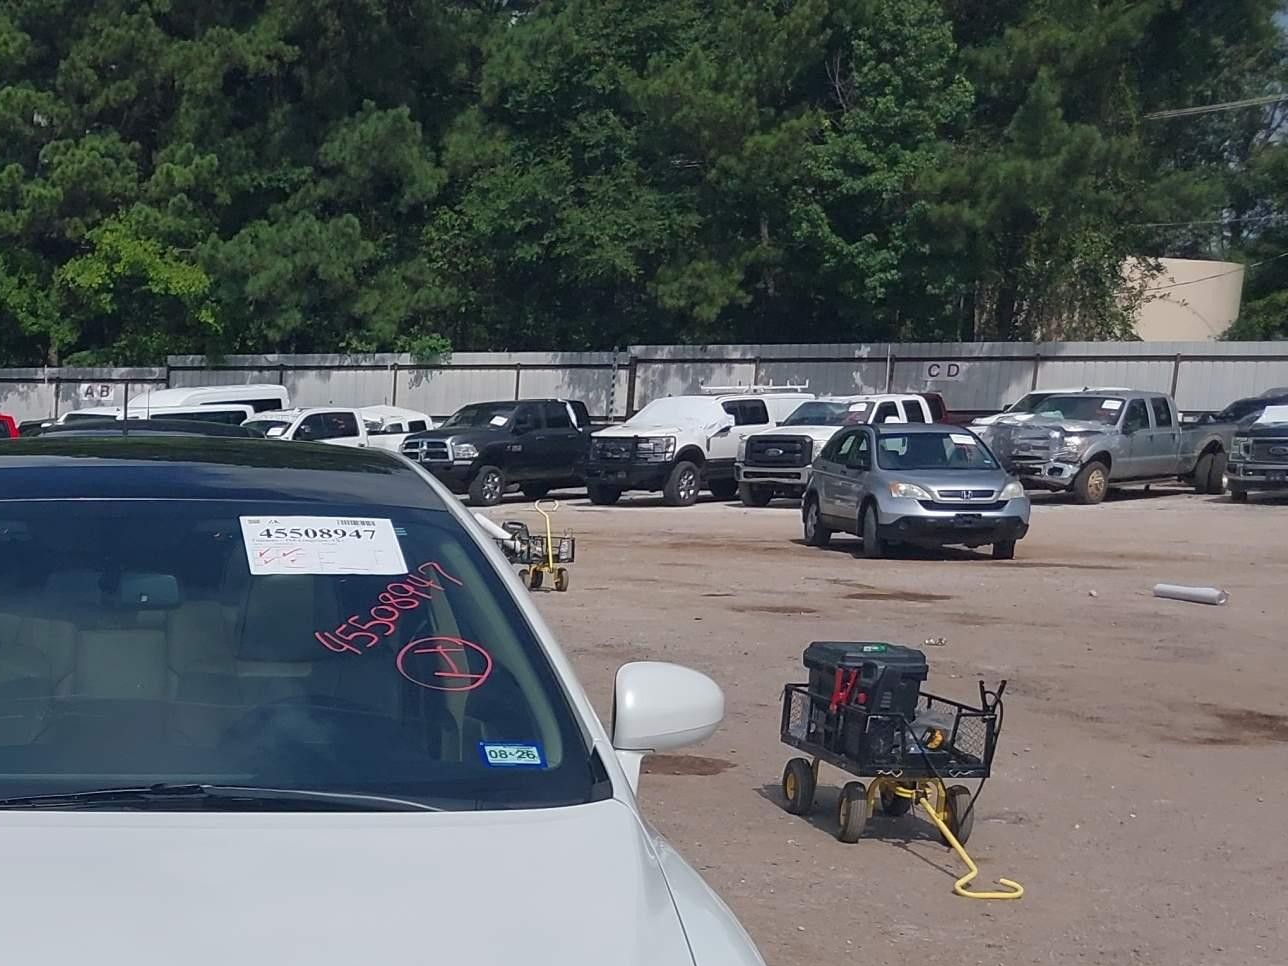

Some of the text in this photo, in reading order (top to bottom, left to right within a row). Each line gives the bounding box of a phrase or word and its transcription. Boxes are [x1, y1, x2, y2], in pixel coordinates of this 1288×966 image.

[927, 363, 960, 378] C D
[84, 385, 111, 398] A B
[259, 528, 376, 540] 45508947
[314, 561, 464, 656] 45508947
